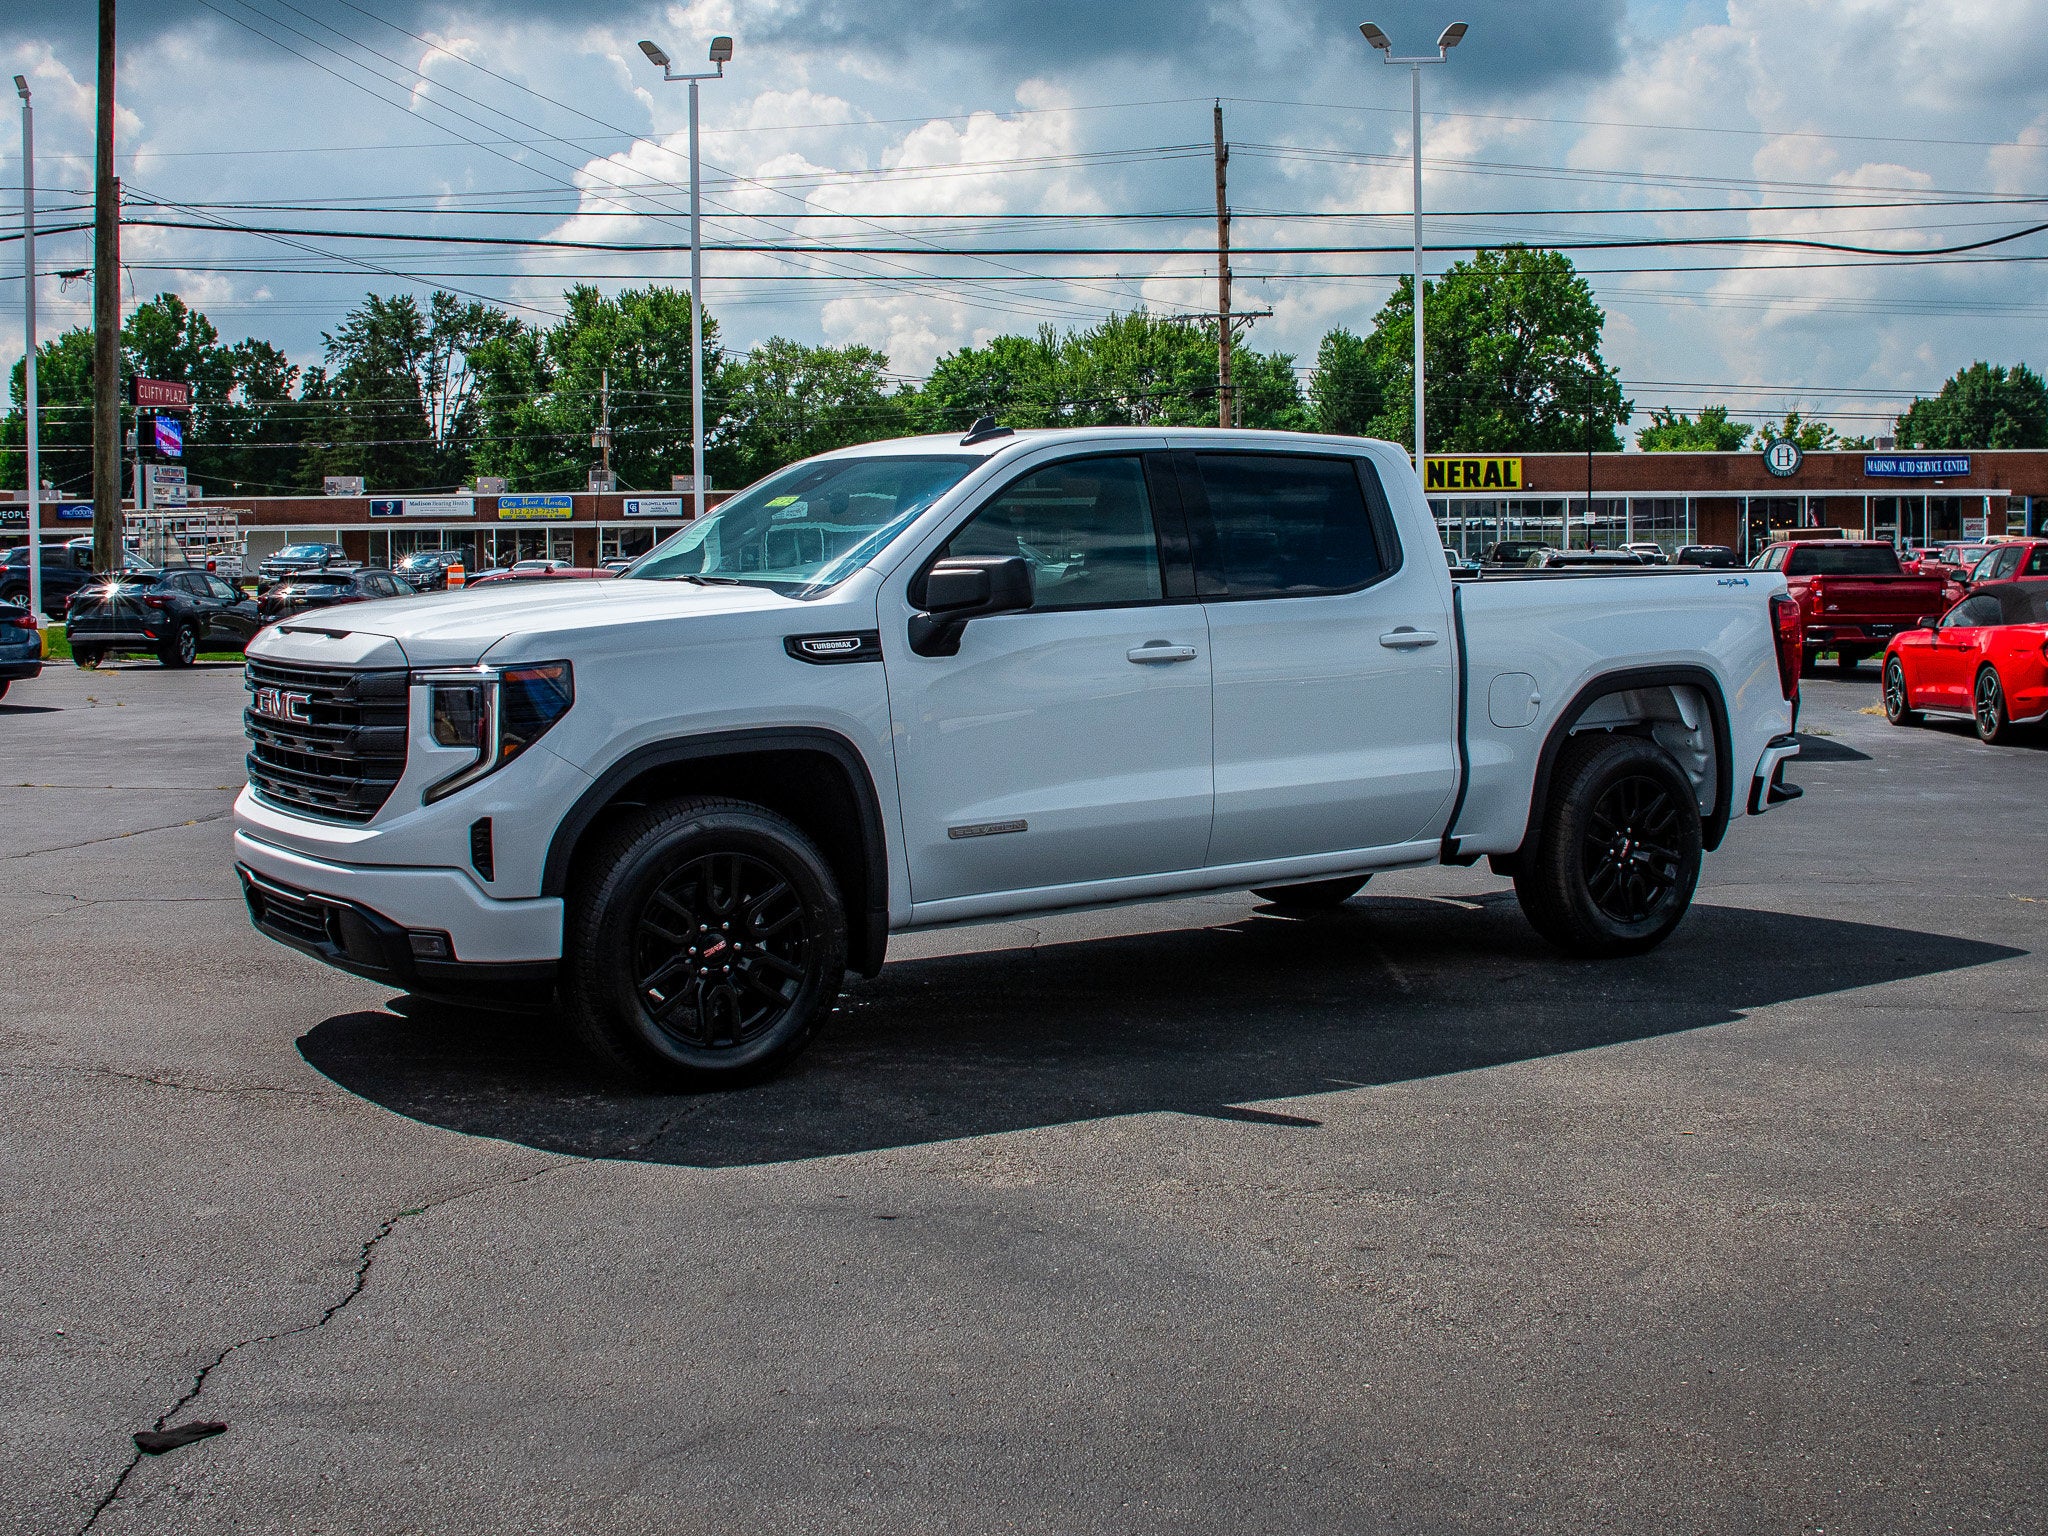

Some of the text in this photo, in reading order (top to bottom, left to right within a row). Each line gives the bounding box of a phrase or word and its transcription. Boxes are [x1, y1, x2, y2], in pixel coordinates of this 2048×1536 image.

[139, 384, 188, 403] CLIFTY PLAZA
[1427, 460, 1517, 488] NERAL
[1867, 459, 1969, 473] MADISON AUTO SERVICE CENTER
[811, 641, 852, 650] TURBOMAX
[255, 687, 312, 725] GMC
